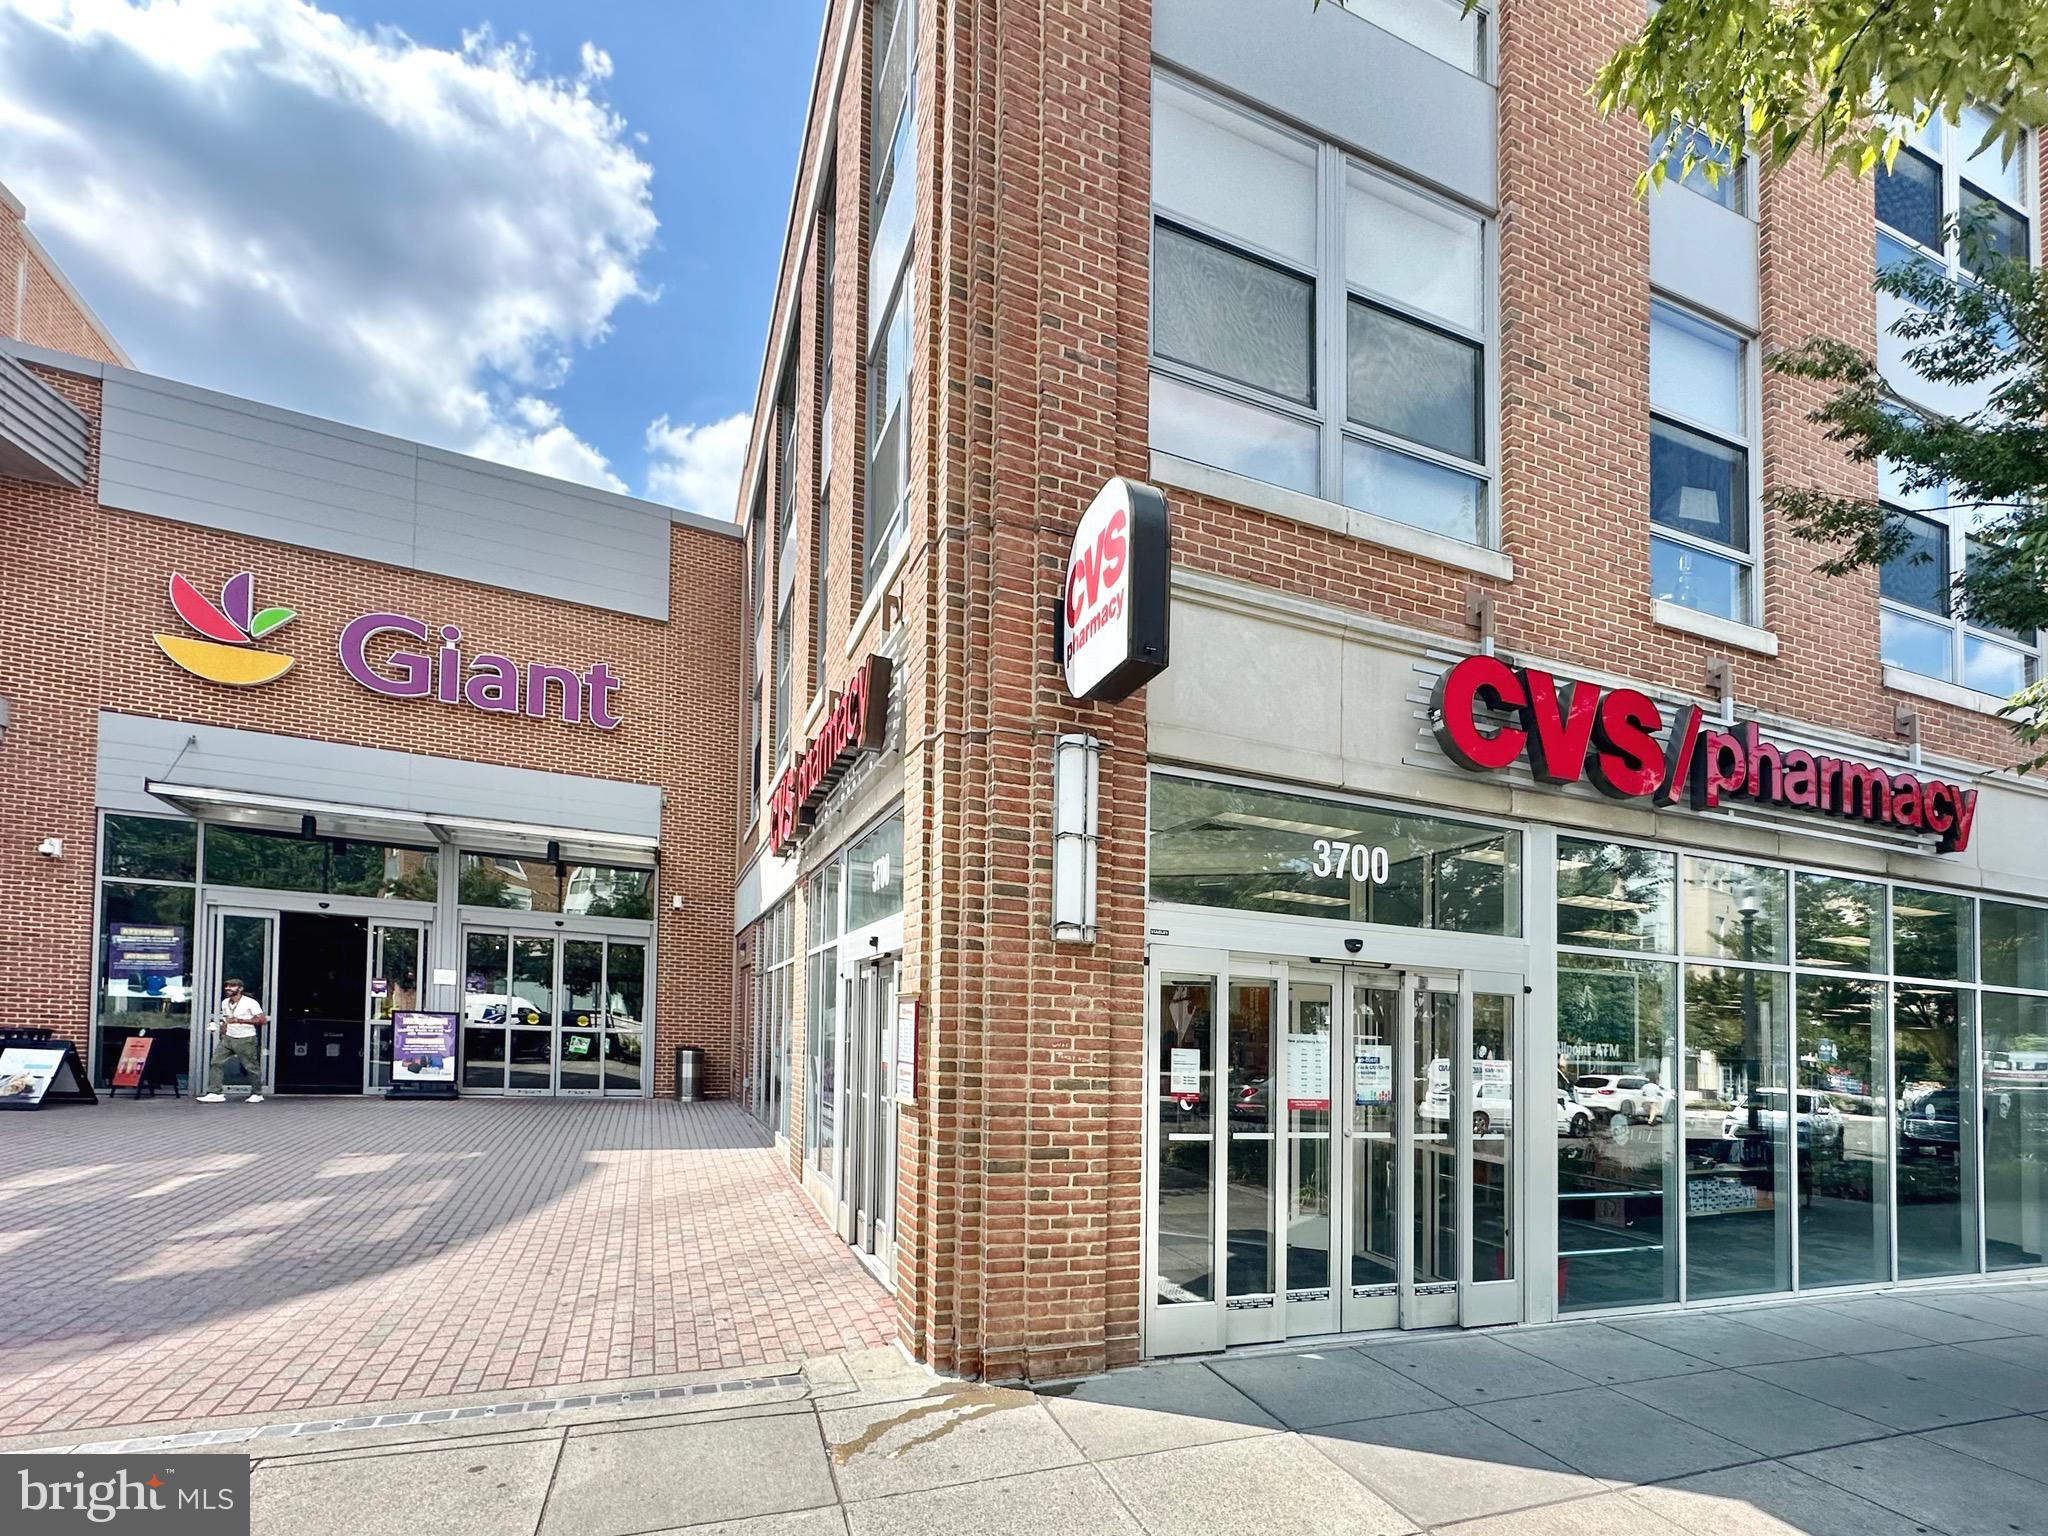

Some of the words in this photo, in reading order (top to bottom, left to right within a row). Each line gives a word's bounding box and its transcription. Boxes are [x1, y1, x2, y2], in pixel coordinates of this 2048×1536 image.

[1066, 509, 1127, 629] CVS
[1066, 588, 1125, 669] pharmacy
[338, 611, 625, 731] Giant
[871, 852, 890, 893] 3700
[1311, 839, 1389, 885] 3700
[1595, 1043, 1620, 1058] ATM
